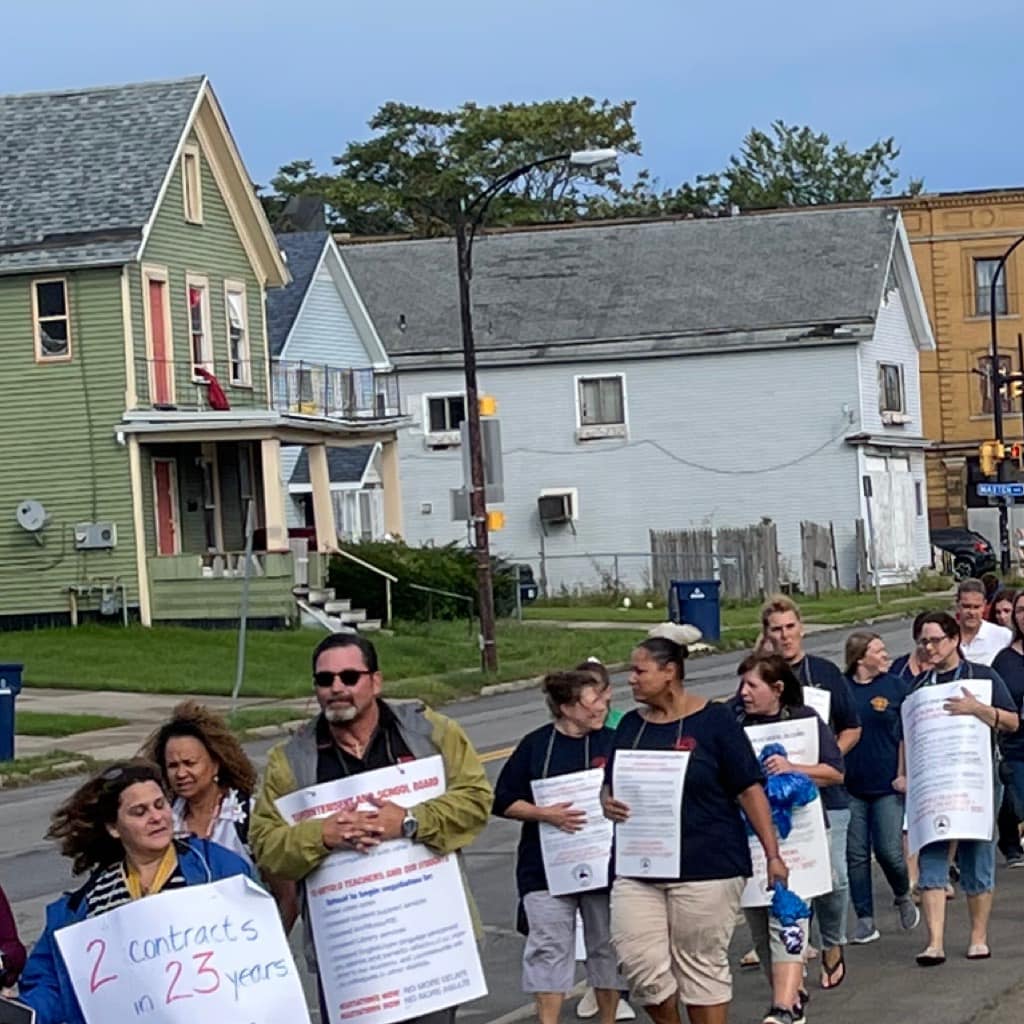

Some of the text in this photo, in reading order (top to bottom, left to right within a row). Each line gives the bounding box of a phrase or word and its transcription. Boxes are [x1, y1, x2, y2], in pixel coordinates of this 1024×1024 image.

[86, 914, 259, 995] 2 contracts
[133, 950, 290, 1017] in 23 years
